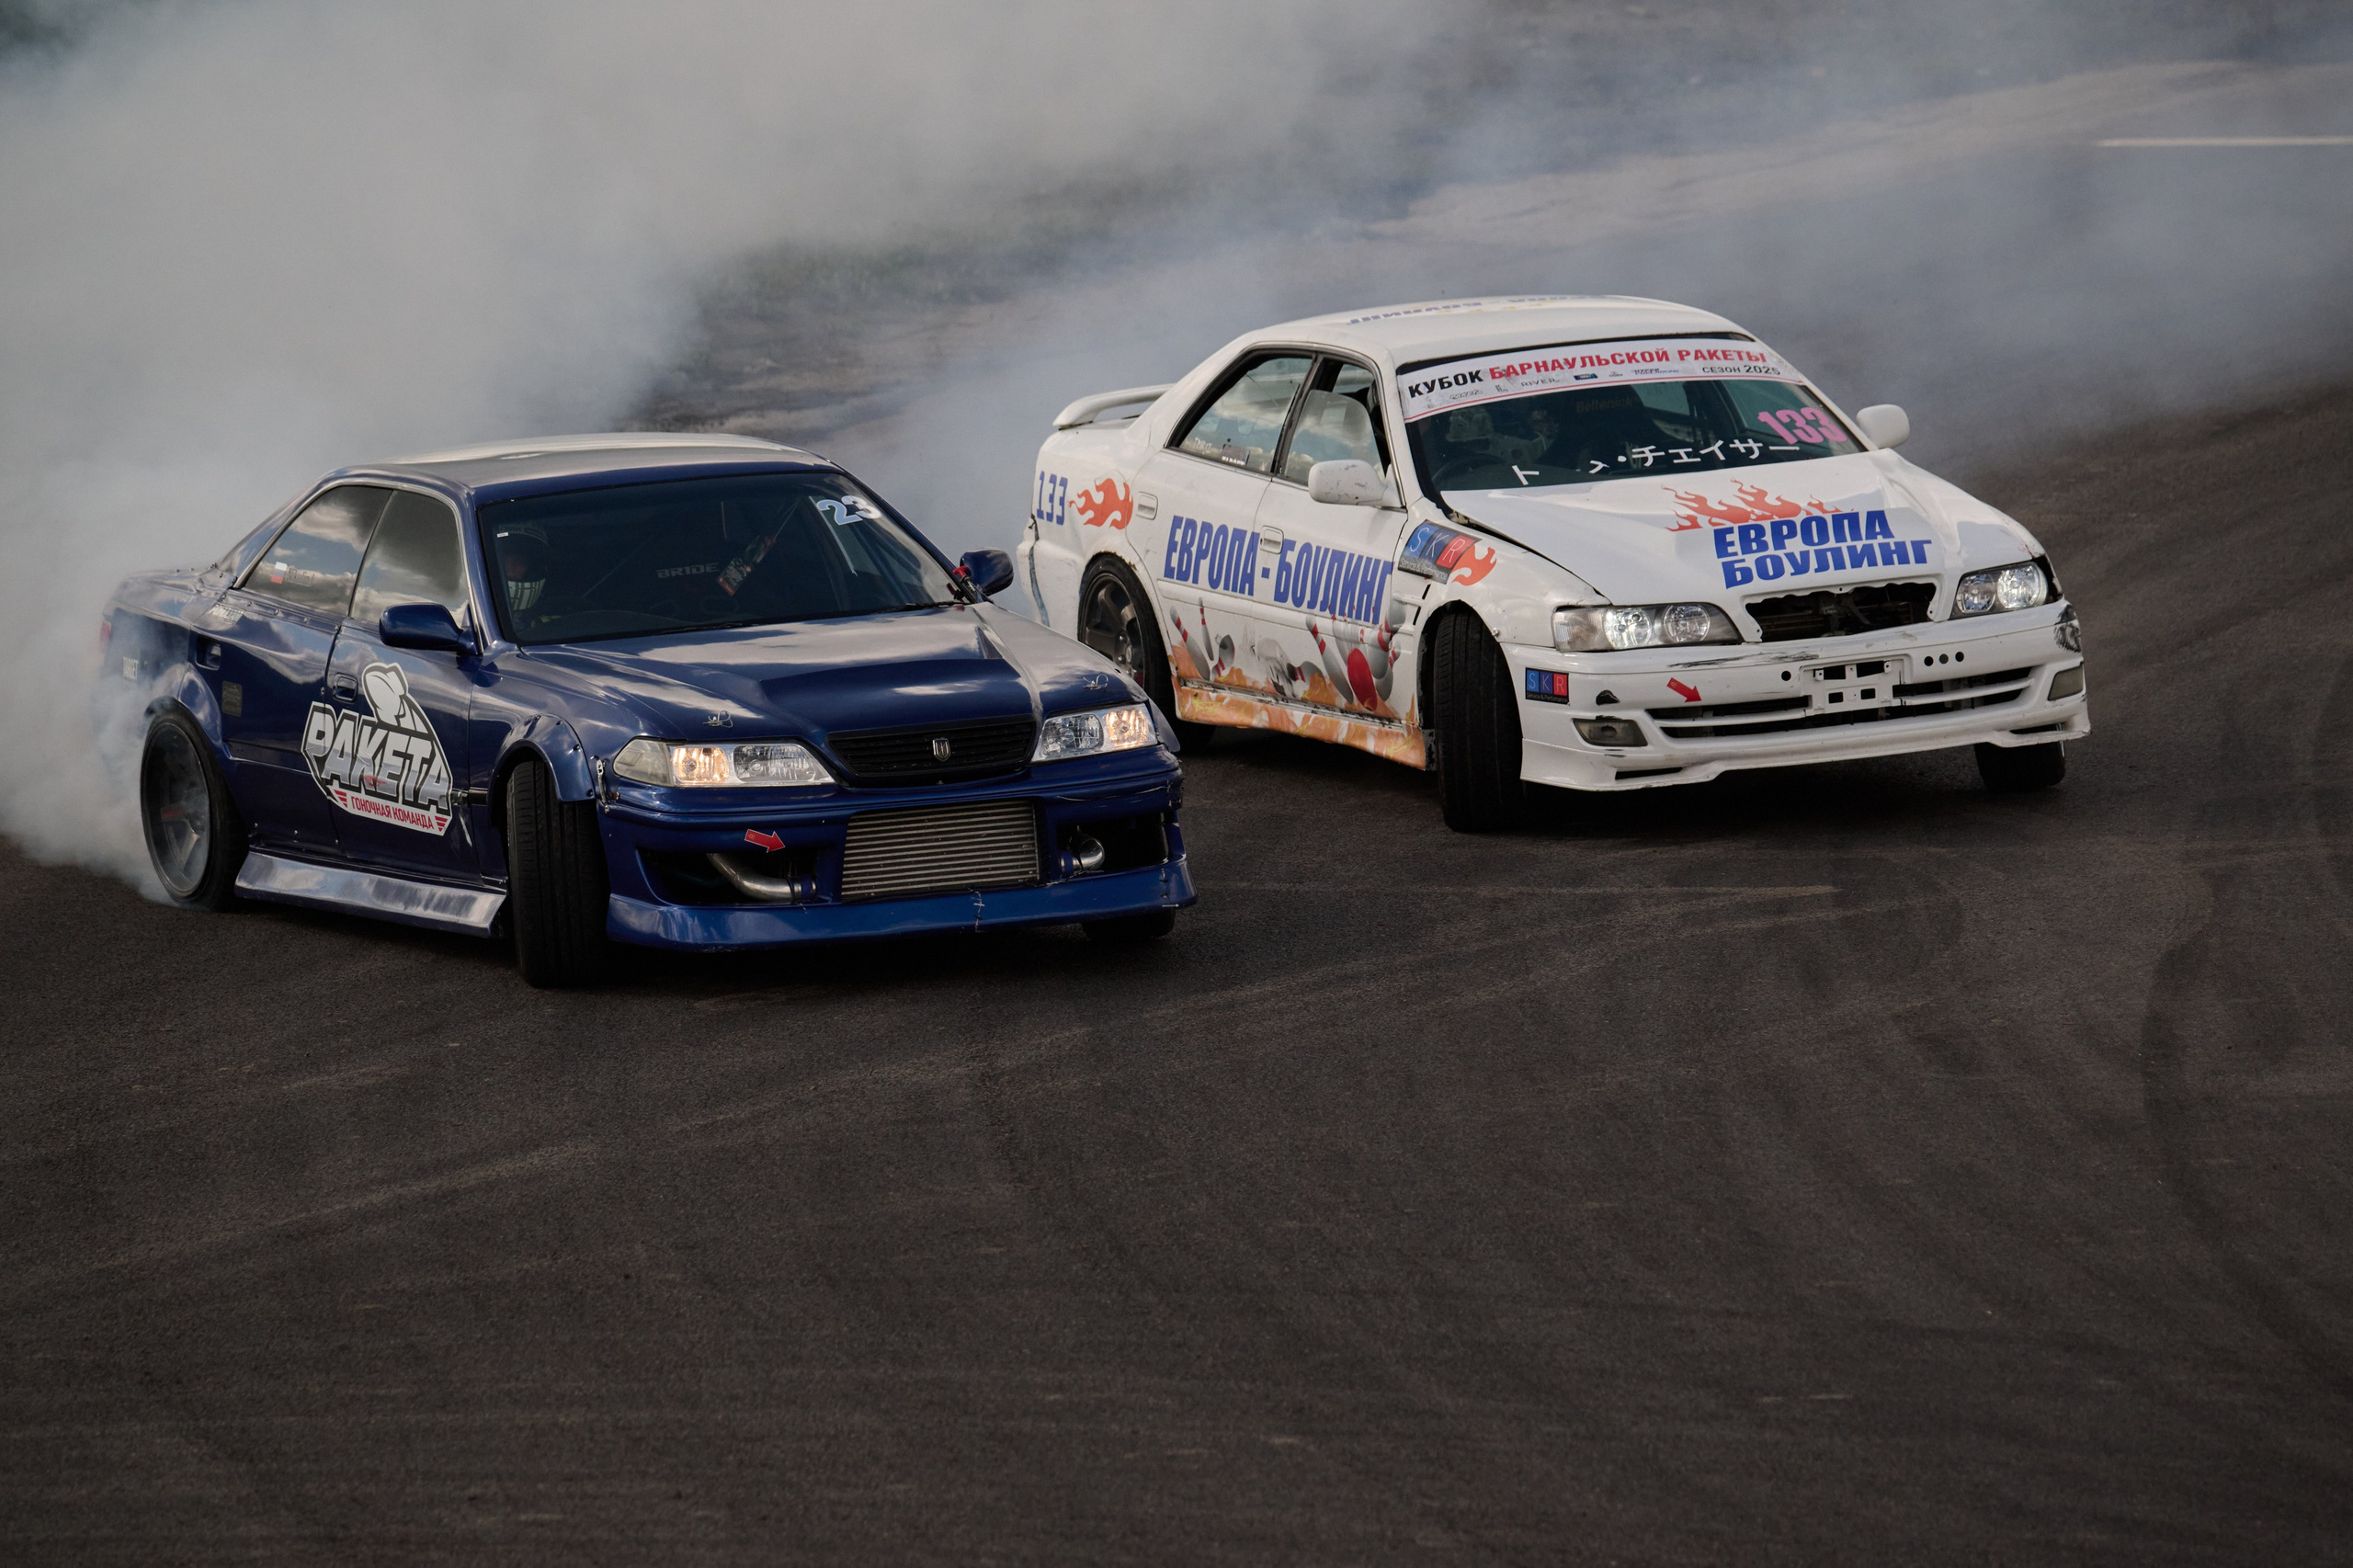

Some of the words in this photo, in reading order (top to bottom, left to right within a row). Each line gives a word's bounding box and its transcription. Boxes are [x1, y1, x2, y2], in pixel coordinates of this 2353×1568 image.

[1408, 369, 1483, 398] КУБОК
[1489, 347, 1670, 381] БАРНАУЛЬСКОЙ
[1677, 348, 1768, 363] РАКЕТЫ
[1702, 365, 1742, 375] СЕЗОН
[1744, 364, 1781, 376] 2025
[1757, 407, 1848, 445] 133
[816, 495, 882, 526] 23
[1036, 470, 1068, 526] 133
[1410, 527, 1465, 563] SKR
[1713, 509, 1895, 560] ЕВРОПА
[656, 562, 720, 579] BRIDE
[1164, 516, 1260, 597] ЕВРОПА
[1274, 539, 1394, 625] БОУЛИНГ
[1722, 540, 1933, 590] БОУЛИНГ
[1529, 673, 1564, 693] SKR
[304, 710, 449, 811] РАКЕТА
[350, 796, 391, 817] ГОНОЧНАЯ
[392, 807, 435, 830] КОМАНДА
